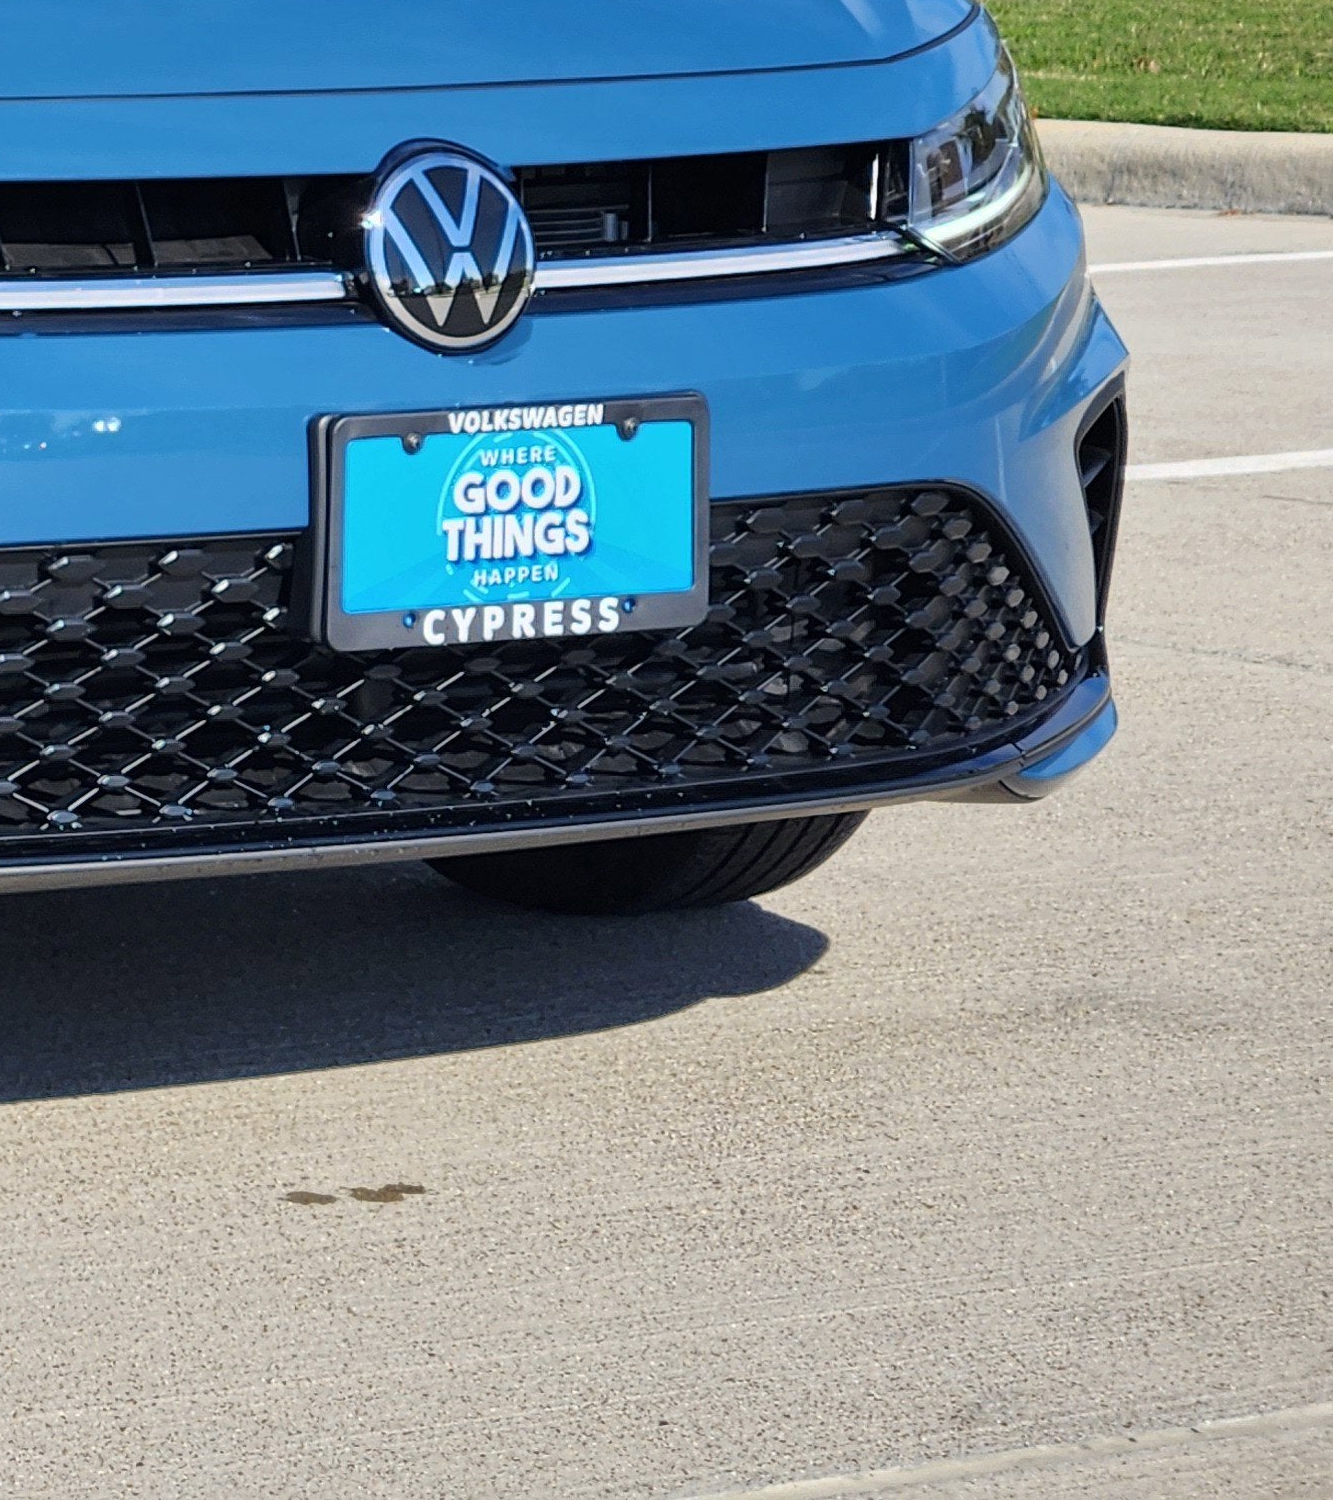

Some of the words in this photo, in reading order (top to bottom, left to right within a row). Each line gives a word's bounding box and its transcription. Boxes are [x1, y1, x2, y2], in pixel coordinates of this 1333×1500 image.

[448, 403, 604, 435] VOLKSWAGEN
[480, 446, 556, 466] WHERE
[453, 466, 580, 513] GOOD
[441, 508, 590, 561] THINGS
[474, 563, 558, 586] HAPPEN
[423, 596, 620, 645] CYPRESS
